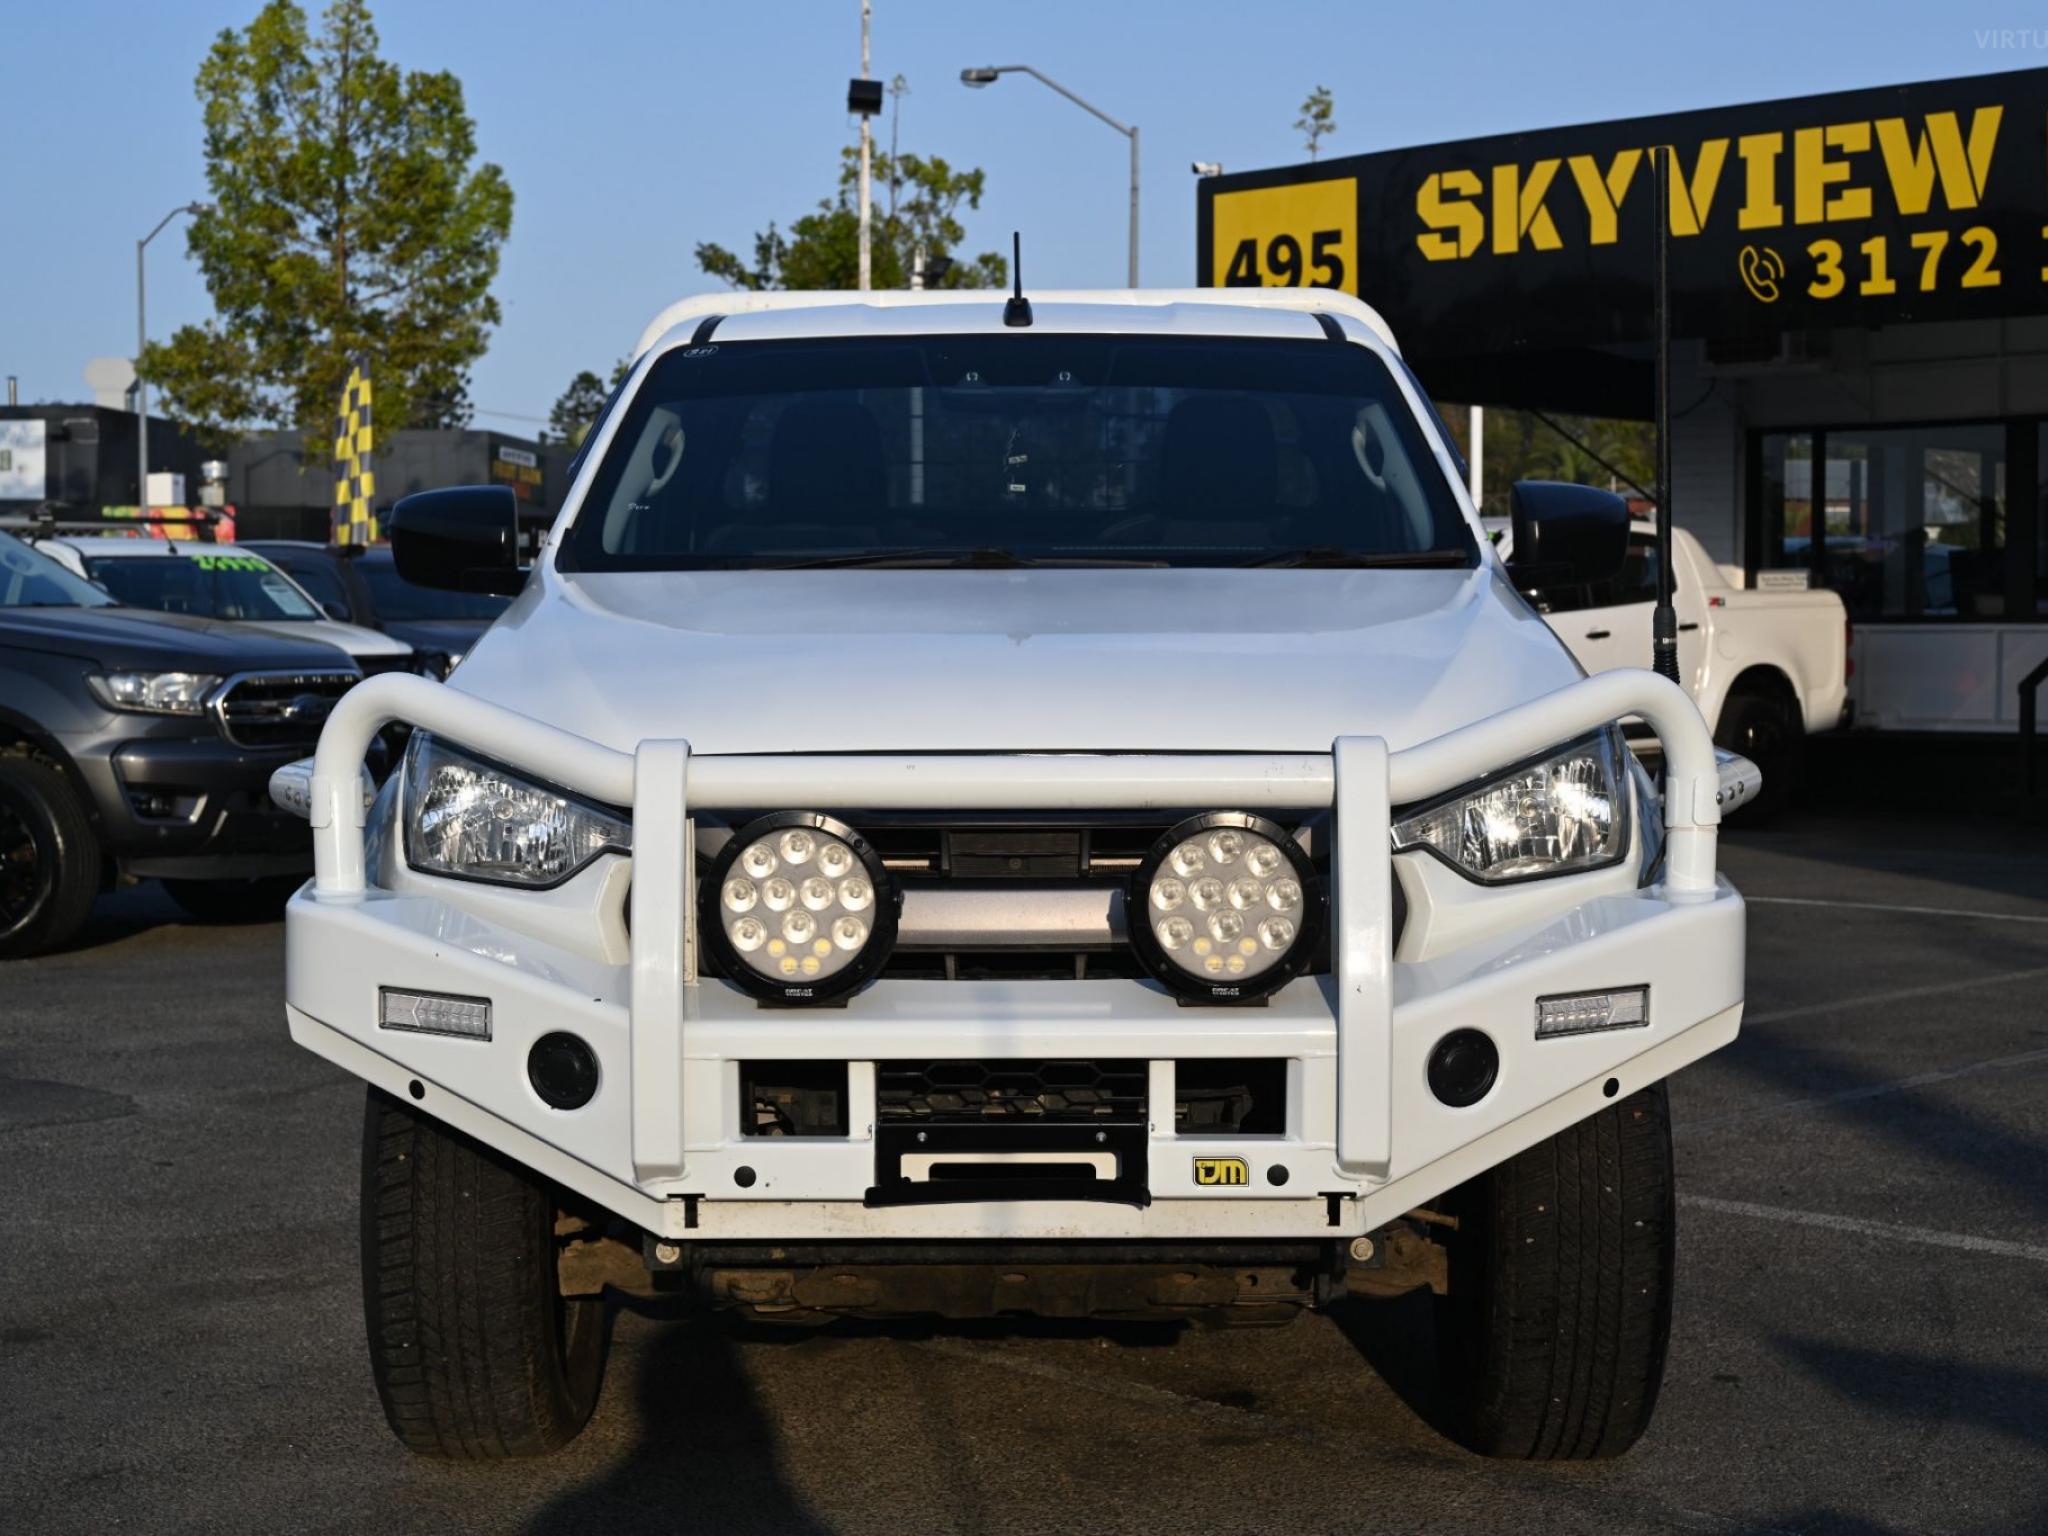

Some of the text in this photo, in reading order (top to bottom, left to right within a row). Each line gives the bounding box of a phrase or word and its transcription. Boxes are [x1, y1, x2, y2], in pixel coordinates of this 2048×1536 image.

[1416, 105, 2004, 261] SKYVIEW
[1225, 229, 1344, 290] 495
[1807, 226, 2001, 299] 3172
